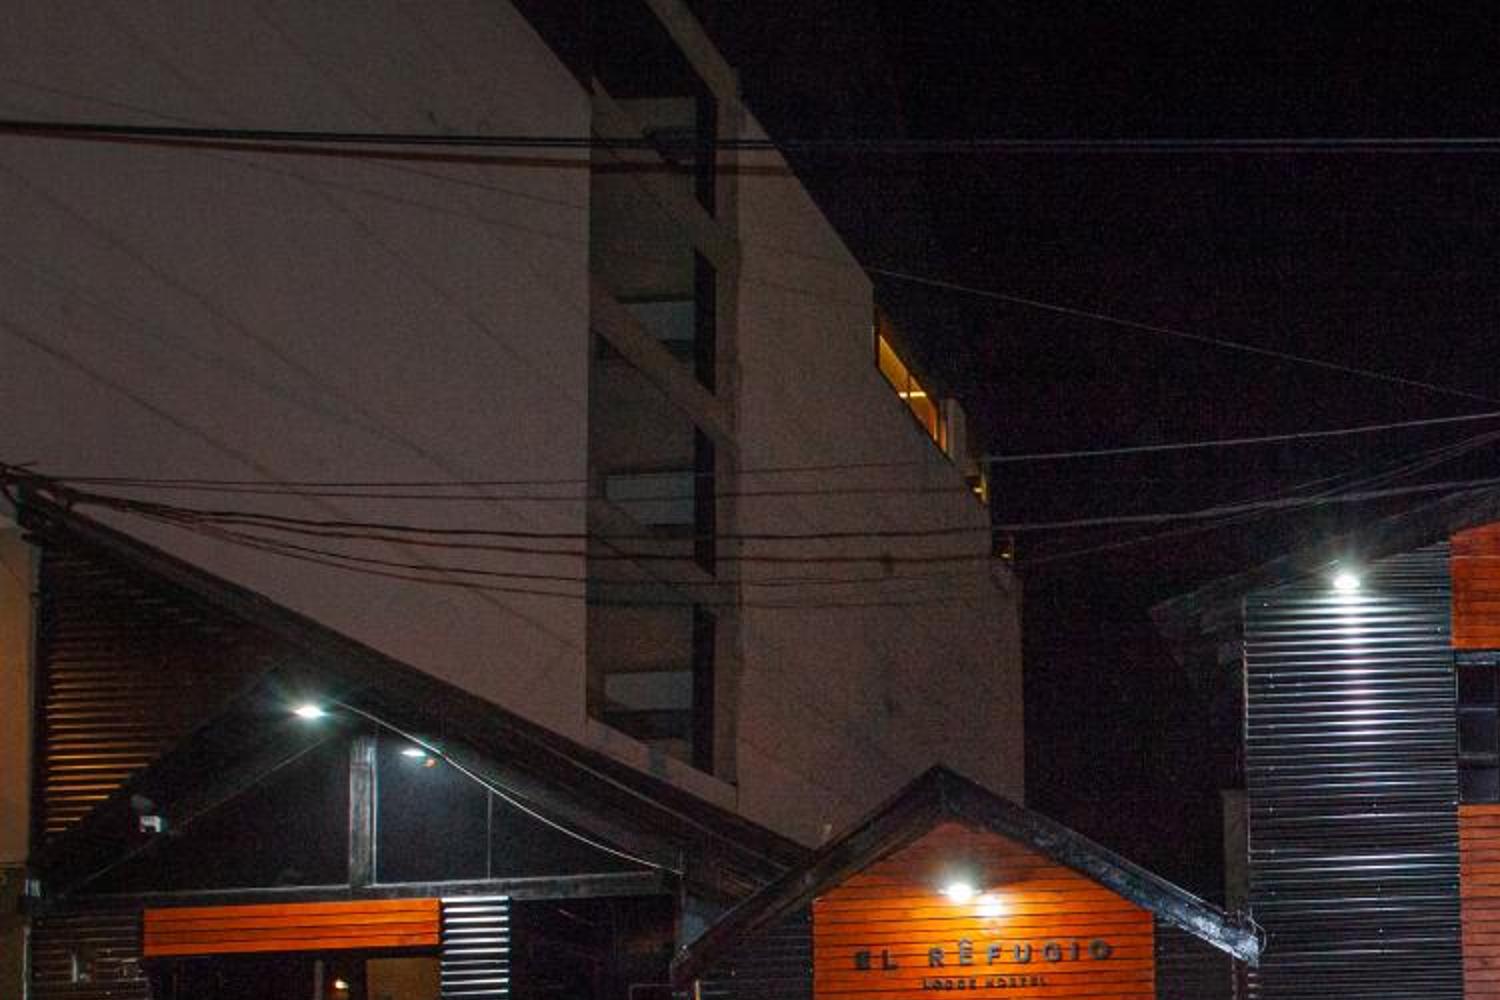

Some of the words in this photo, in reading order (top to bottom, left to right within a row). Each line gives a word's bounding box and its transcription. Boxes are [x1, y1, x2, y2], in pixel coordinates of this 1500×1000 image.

[854, 949, 898, 971] EL
[924, 977, 978, 991] LODGE
[985, 974, 1047, 989] HOSTEL
